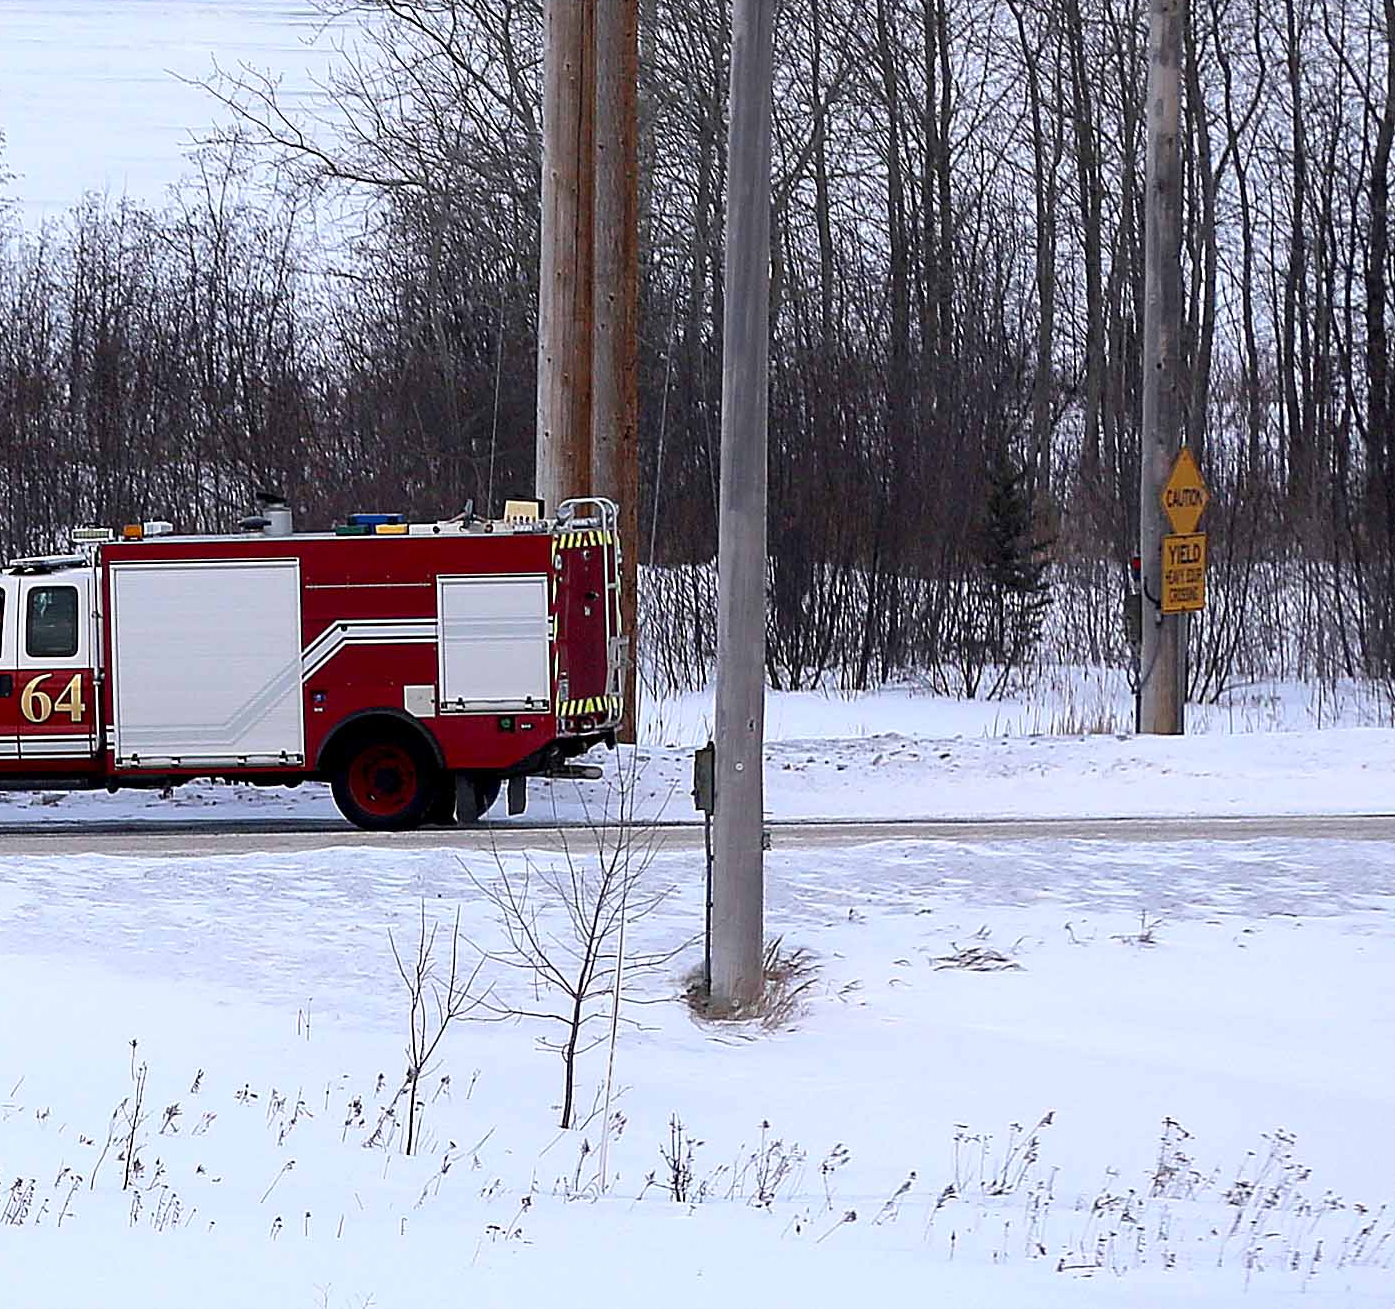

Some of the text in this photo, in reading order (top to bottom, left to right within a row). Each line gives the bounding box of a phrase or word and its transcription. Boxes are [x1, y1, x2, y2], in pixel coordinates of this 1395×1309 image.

[1166, 488, 1203, 508] CAUTION
[1169, 544, 1202, 564] YIELD
[21, 673, 86, 722] 64
